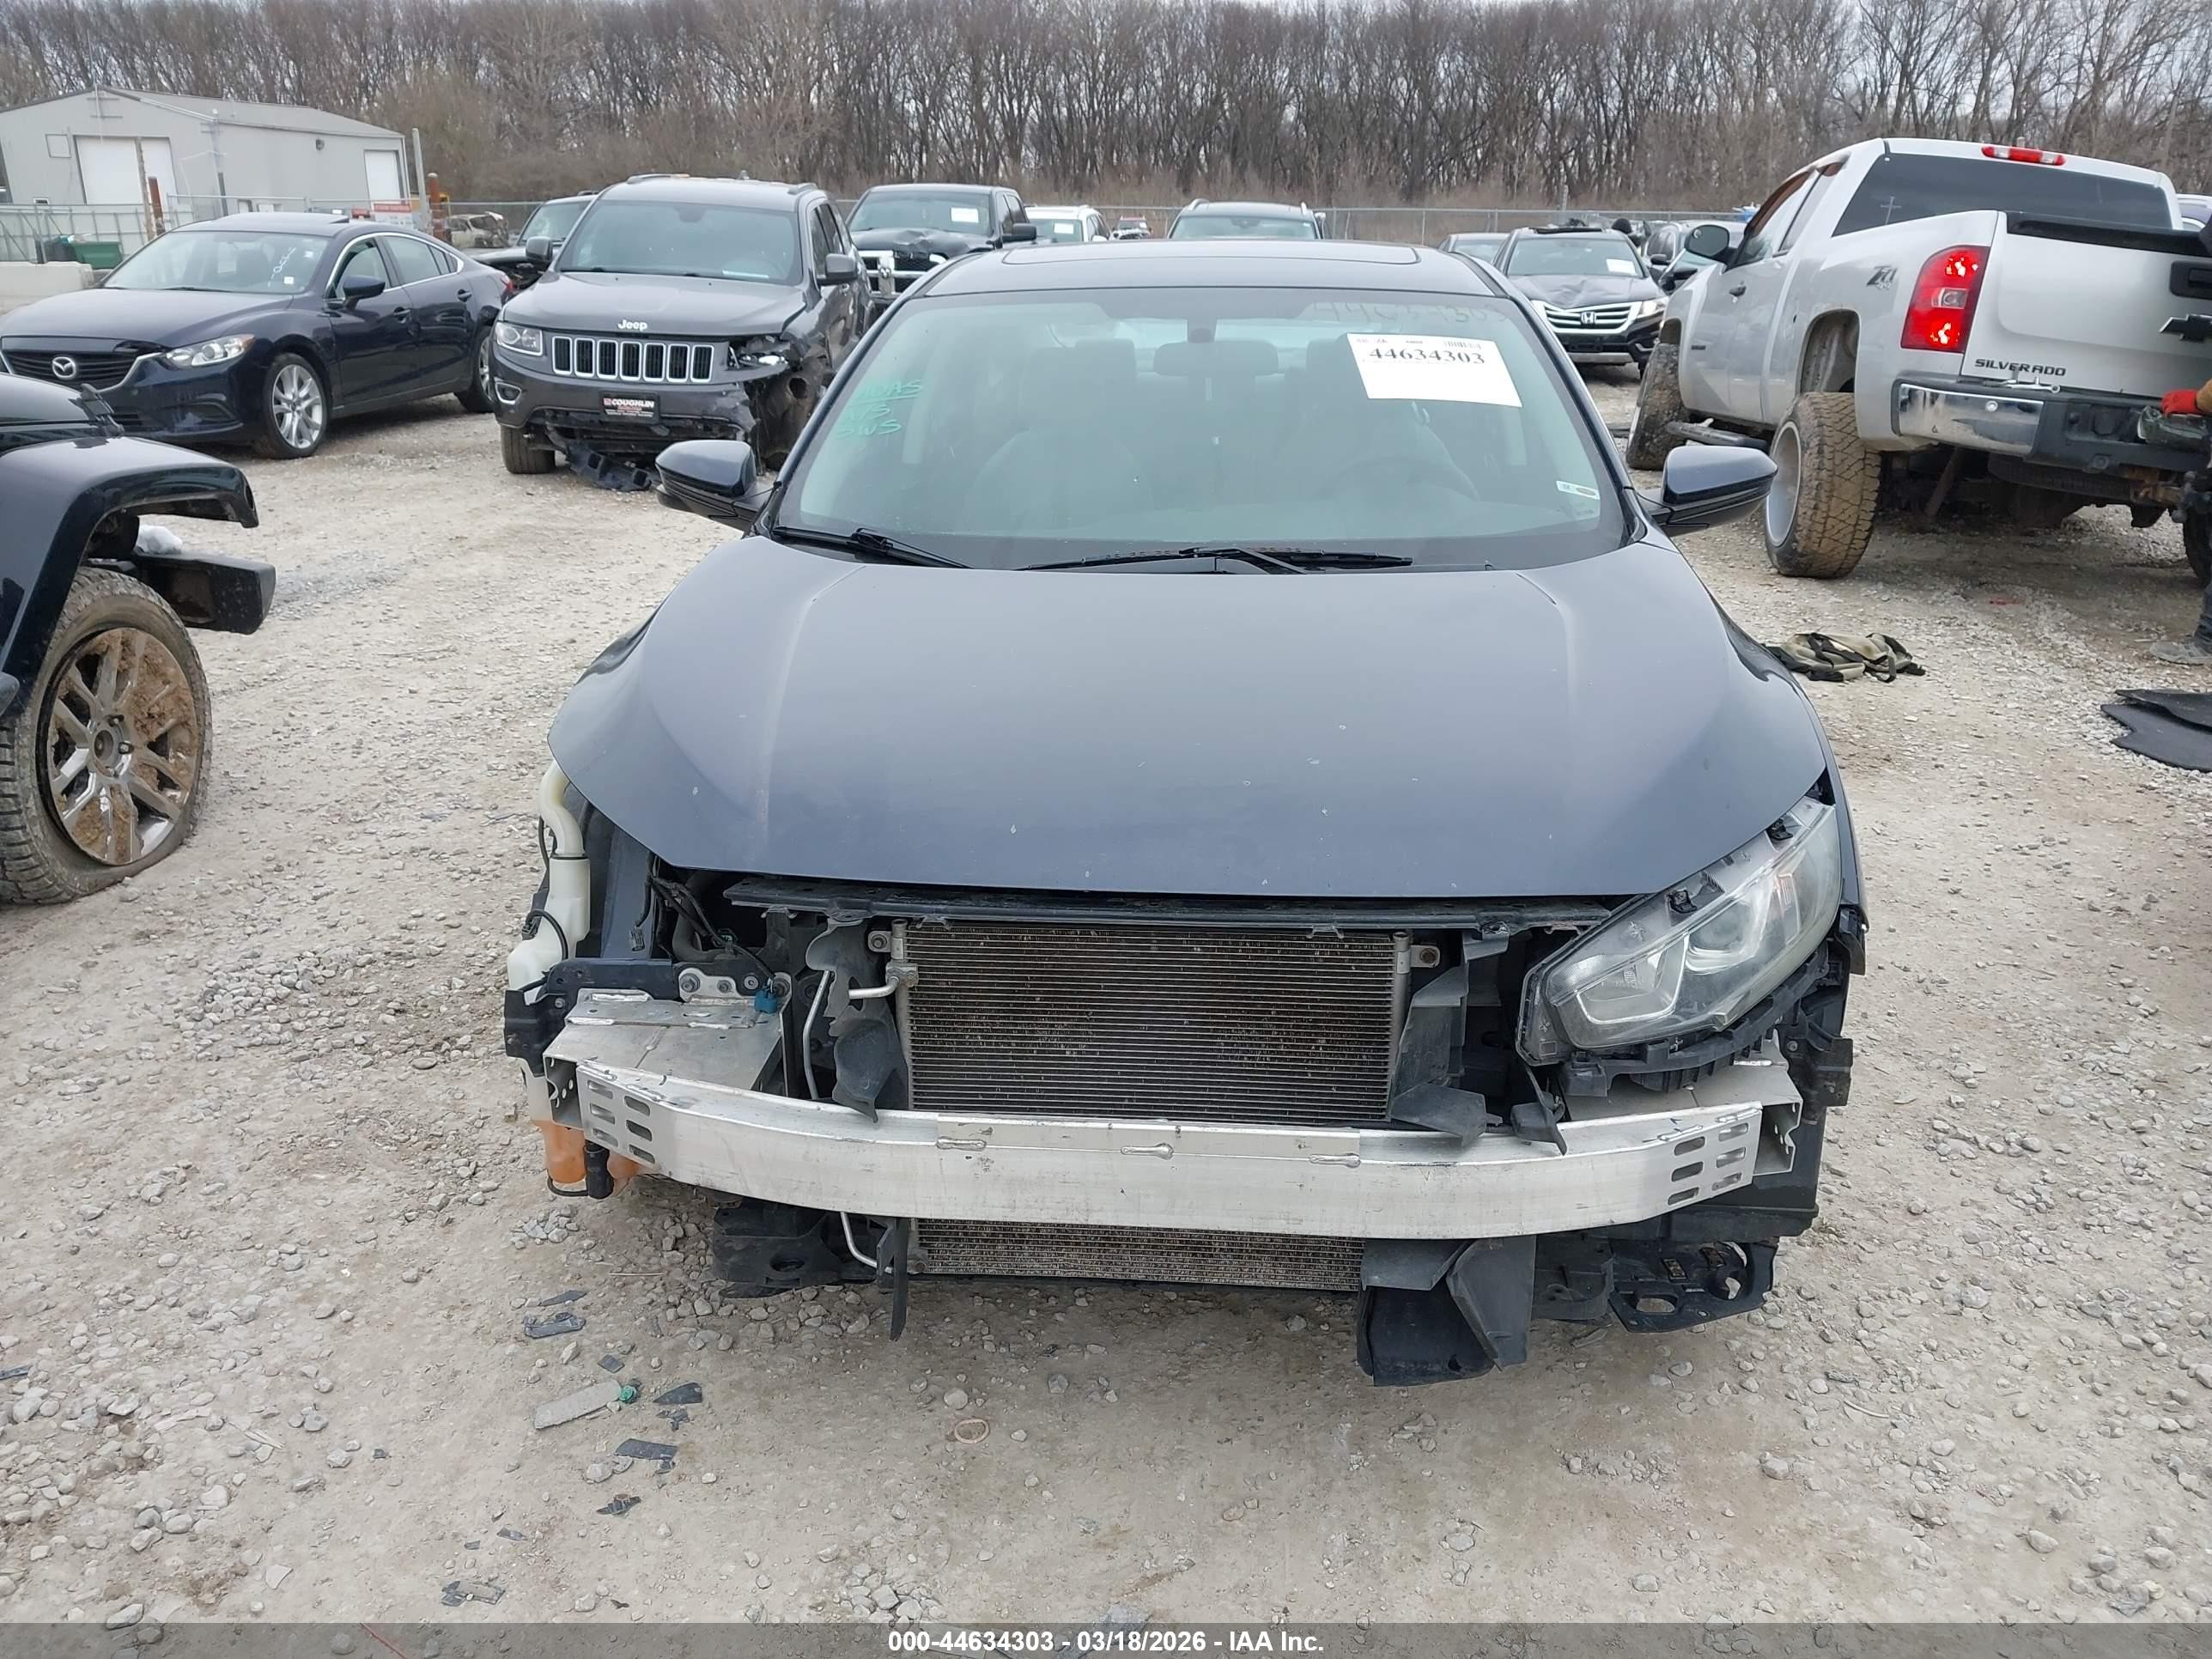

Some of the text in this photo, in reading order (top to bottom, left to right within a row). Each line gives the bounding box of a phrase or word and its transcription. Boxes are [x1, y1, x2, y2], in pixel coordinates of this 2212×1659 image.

[617, 319, 647, 331] Jeep
[1369, 348, 1486, 365] 44634303
[1974, 358, 2066, 377] SILVERADO
[611, 398, 654, 409] COUGHLIN
